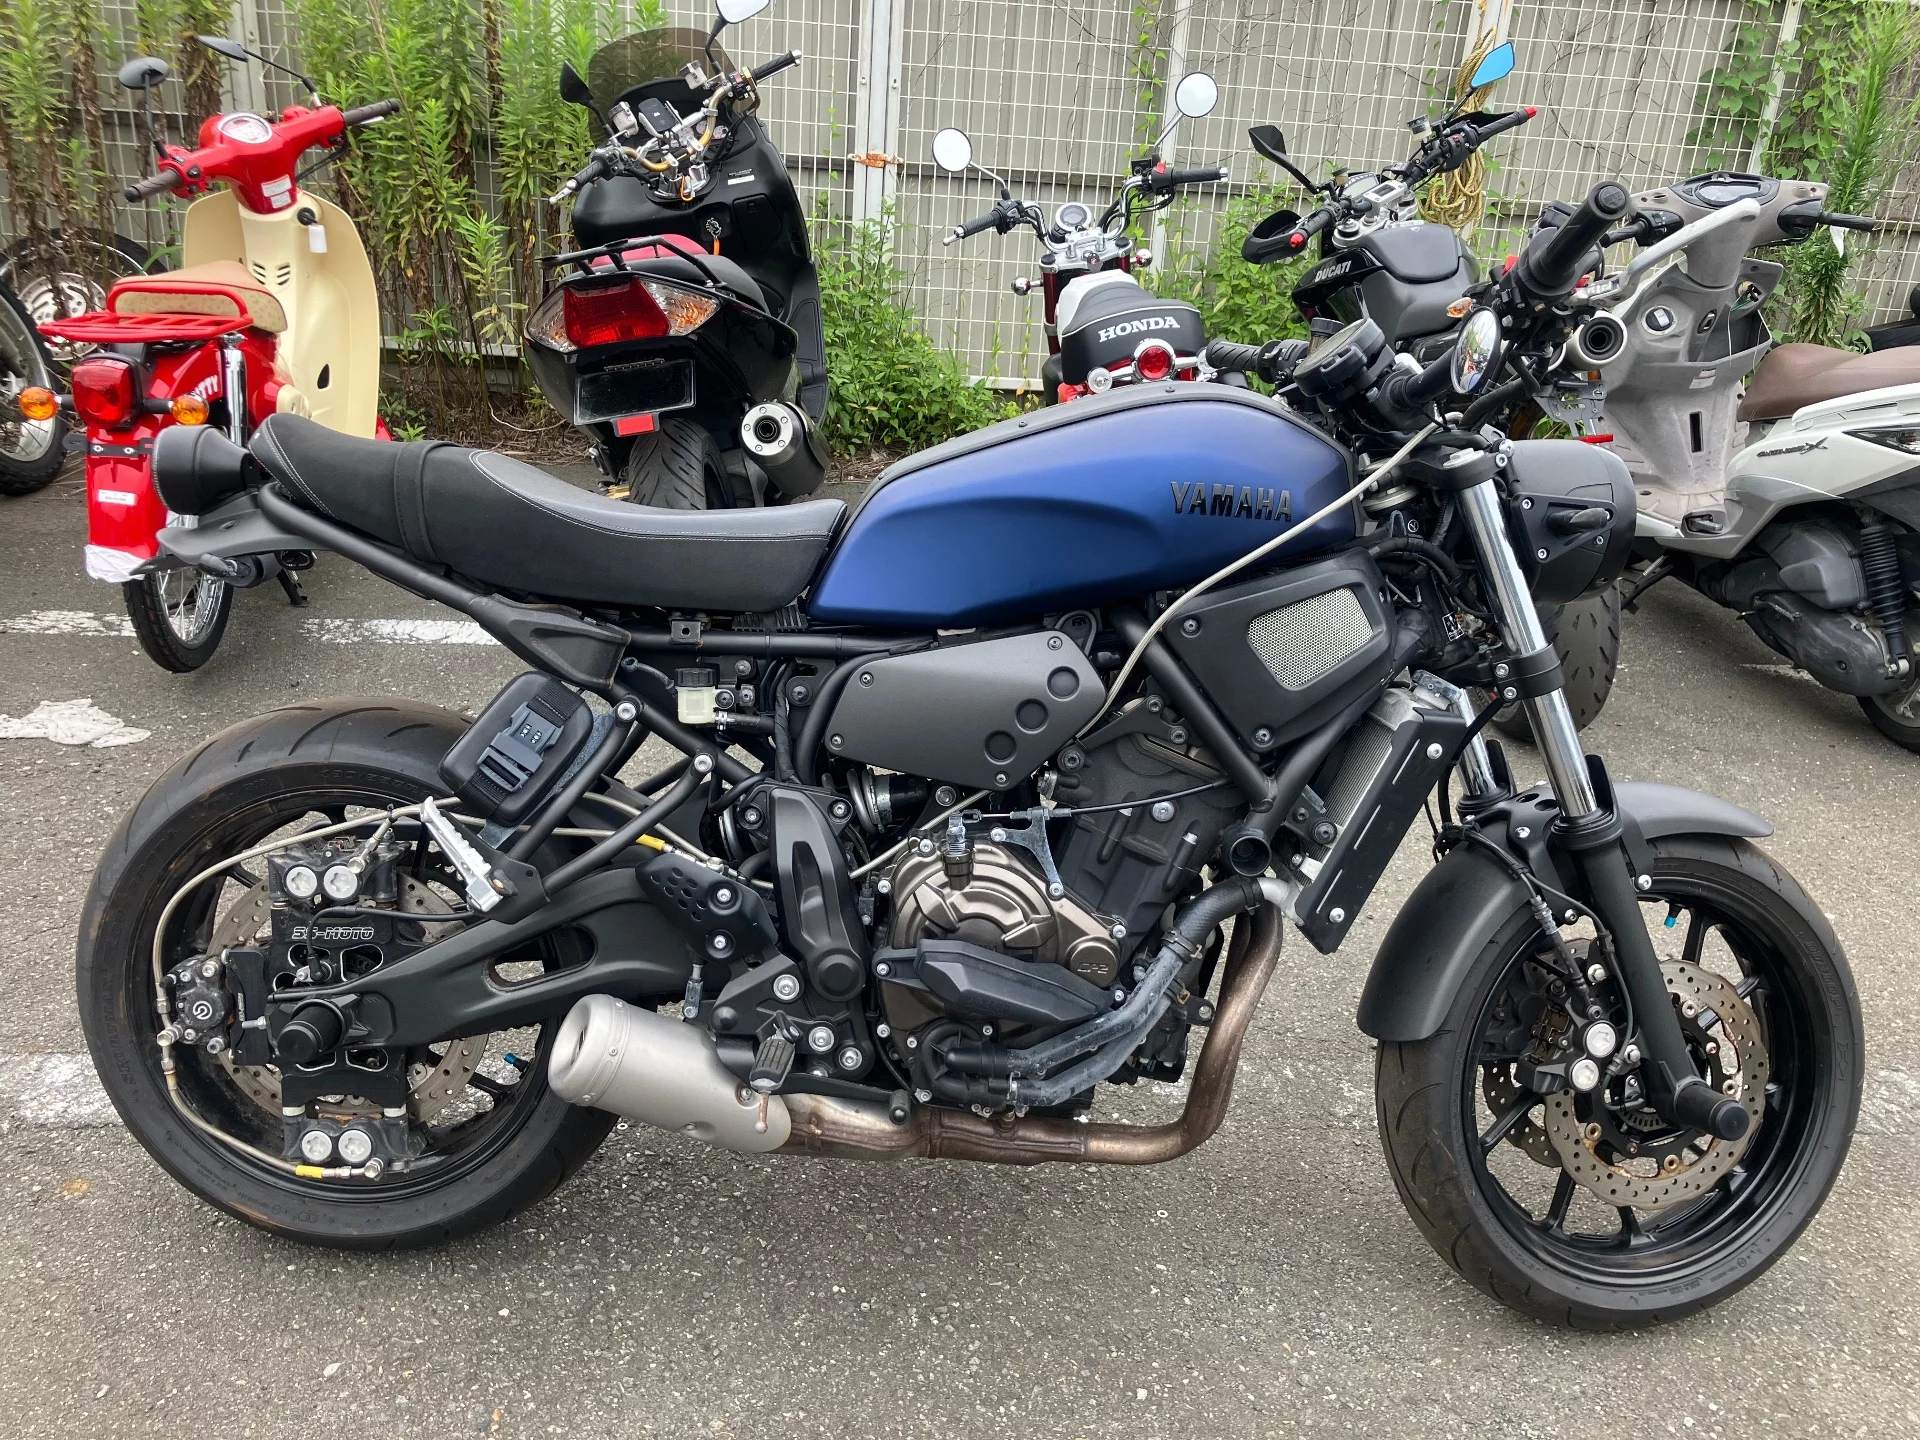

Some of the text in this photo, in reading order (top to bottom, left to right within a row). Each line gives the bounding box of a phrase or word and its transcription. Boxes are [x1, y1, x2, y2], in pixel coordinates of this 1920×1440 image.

[1314, 260, 1352, 283] DUCATI
[1097, 316, 1181, 343] HONDA
[1170, 481, 1292, 522] YAMAHA
